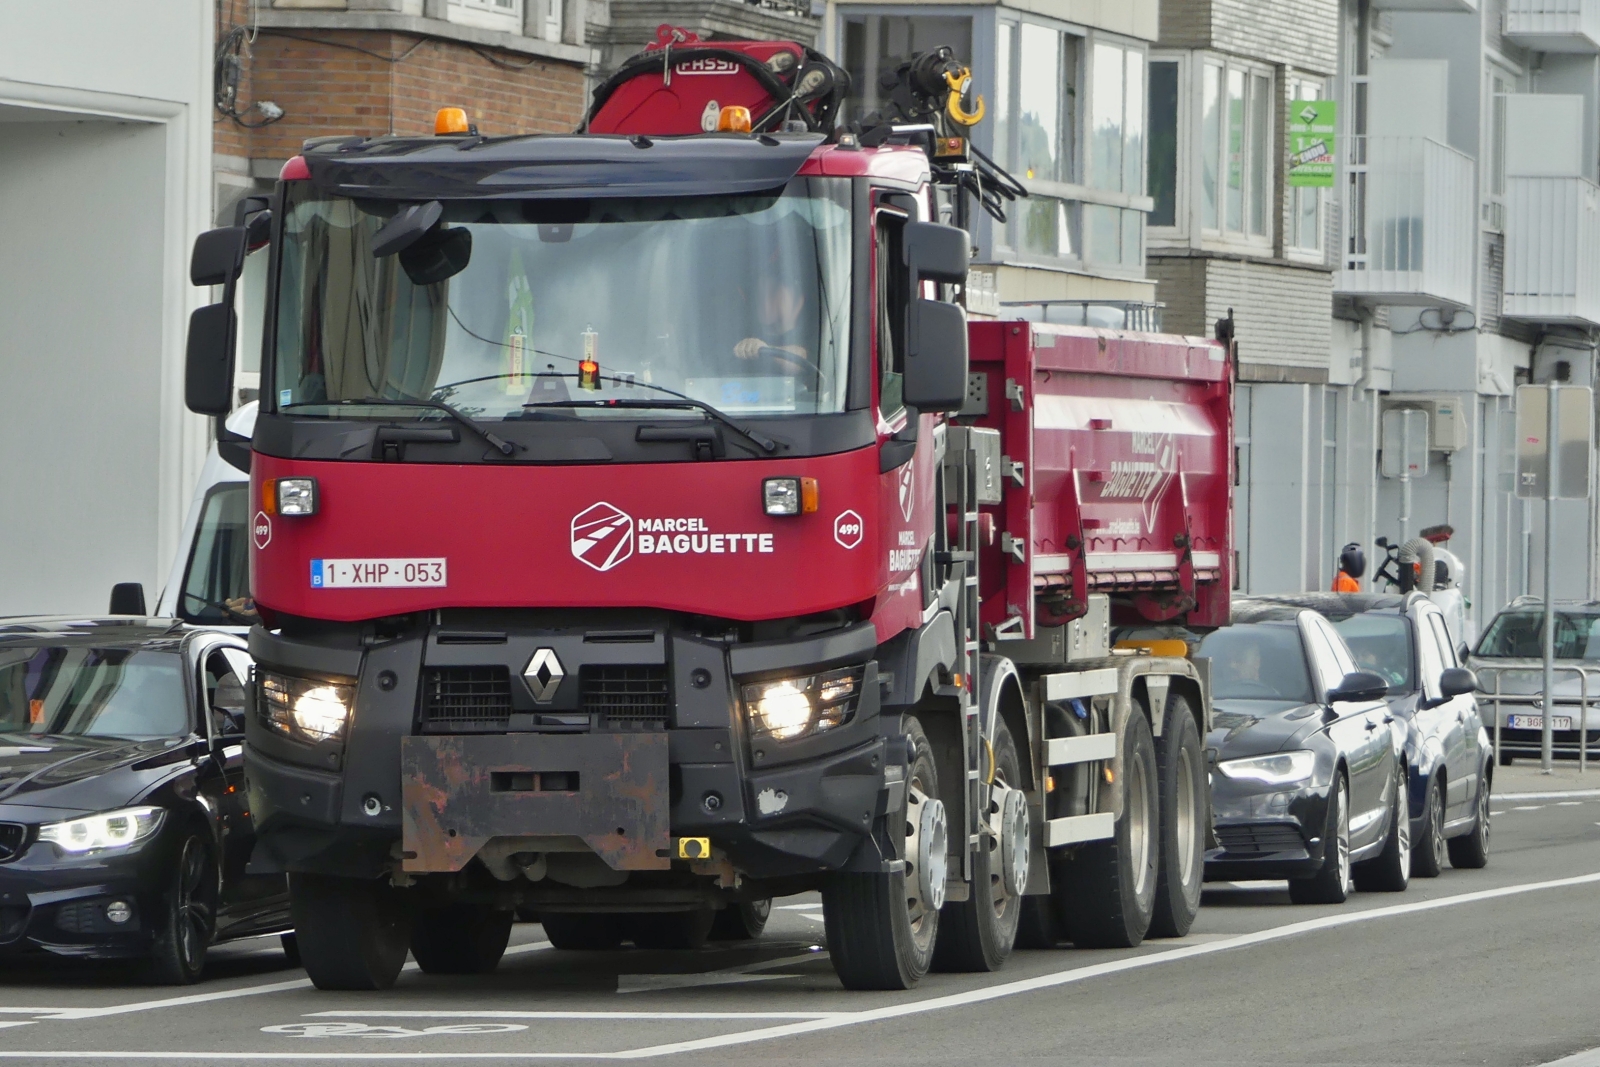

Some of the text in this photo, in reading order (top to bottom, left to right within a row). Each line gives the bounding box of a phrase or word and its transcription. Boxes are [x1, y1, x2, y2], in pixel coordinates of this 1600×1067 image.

[255, 525, 268, 536] 499
[638, 518, 708, 532] MARCEL
[838, 523, 860, 536] 499
[638, 533, 774, 554] BAGUETTE
[313, 563, 443, 585] B 1-XHP-053
